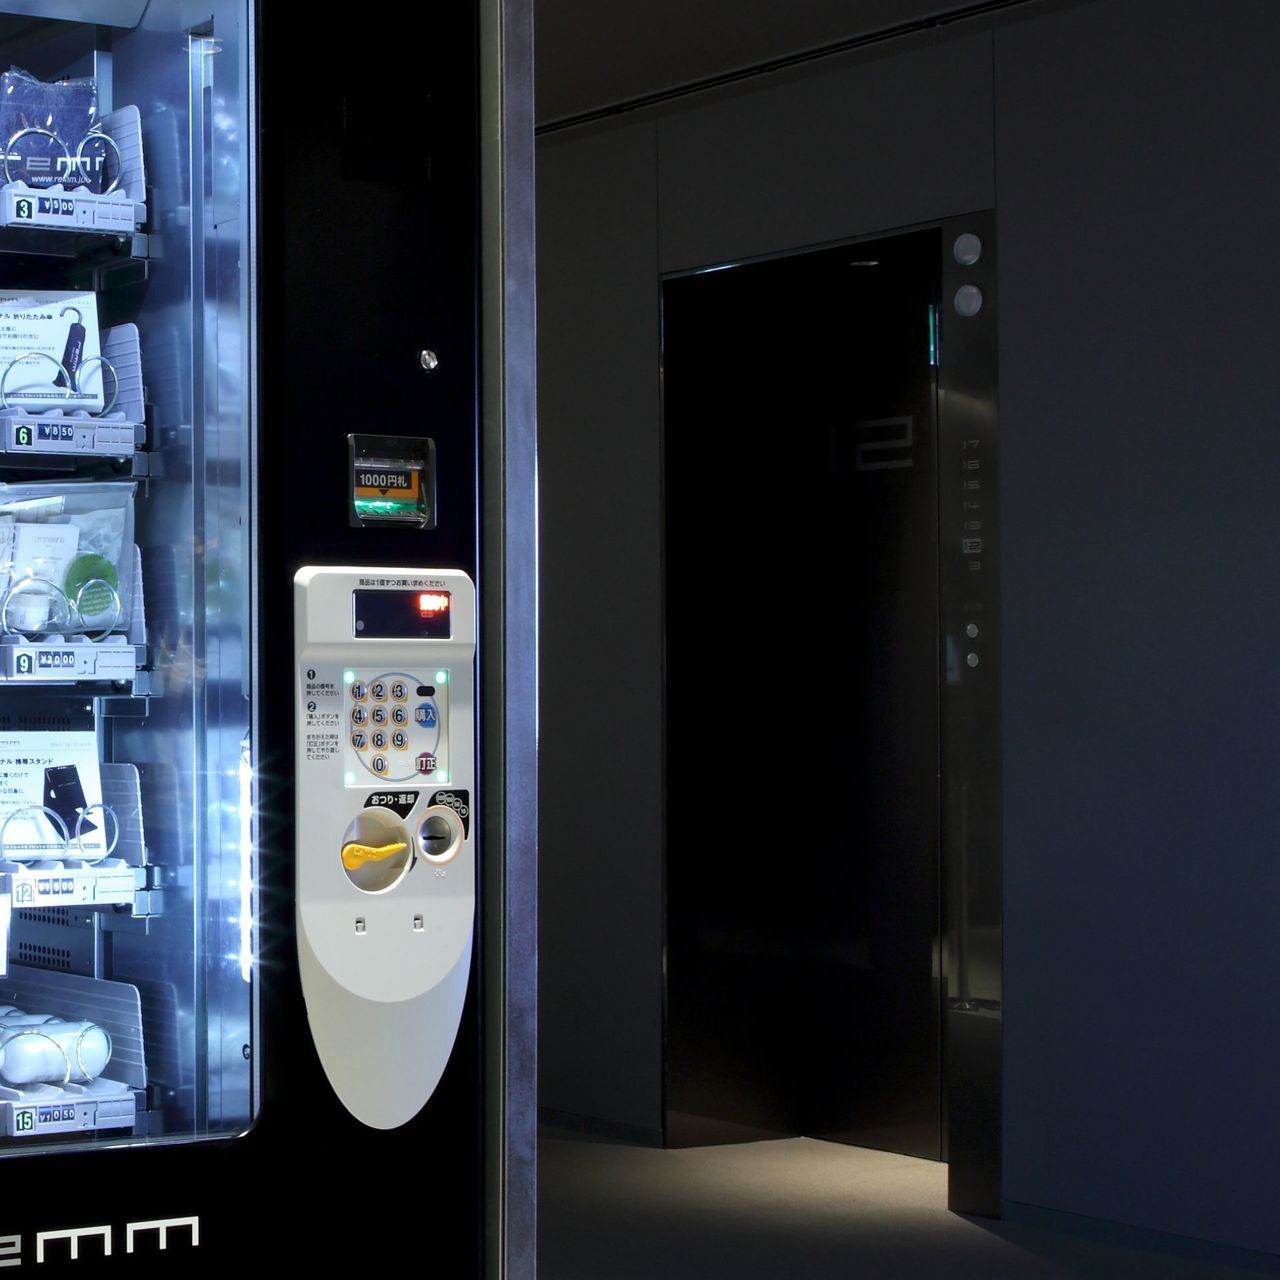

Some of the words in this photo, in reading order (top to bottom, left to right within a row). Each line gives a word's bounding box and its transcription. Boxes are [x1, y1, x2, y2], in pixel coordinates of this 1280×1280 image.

[20, 201, 29, 218] 3
[19, 428, 28, 444] 6
[44, 426, 73, 437] ¥850
[359, 473, 408, 488] 1000円札
[20, 658, 29, 672] 9
[356, 684, 361, 698] 1
[376, 684, 383, 698] 2
[395, 684, 403, 698] 3
[355, 709, 363, 723] 4
[375, 709, 383, 723] 5
[395, 709, 403, 723] 6
[356, 734, 363, 748] 7
[376, 733, 383, 747] 8
[395, 733, 403, 747] 9
[14, 758, 54, 766] 携帯スタンド
[375, 758, 384, 772] 0
[371, 793, 416, 805] おつり・返却
[16, 1113, 32, 1131] 15
